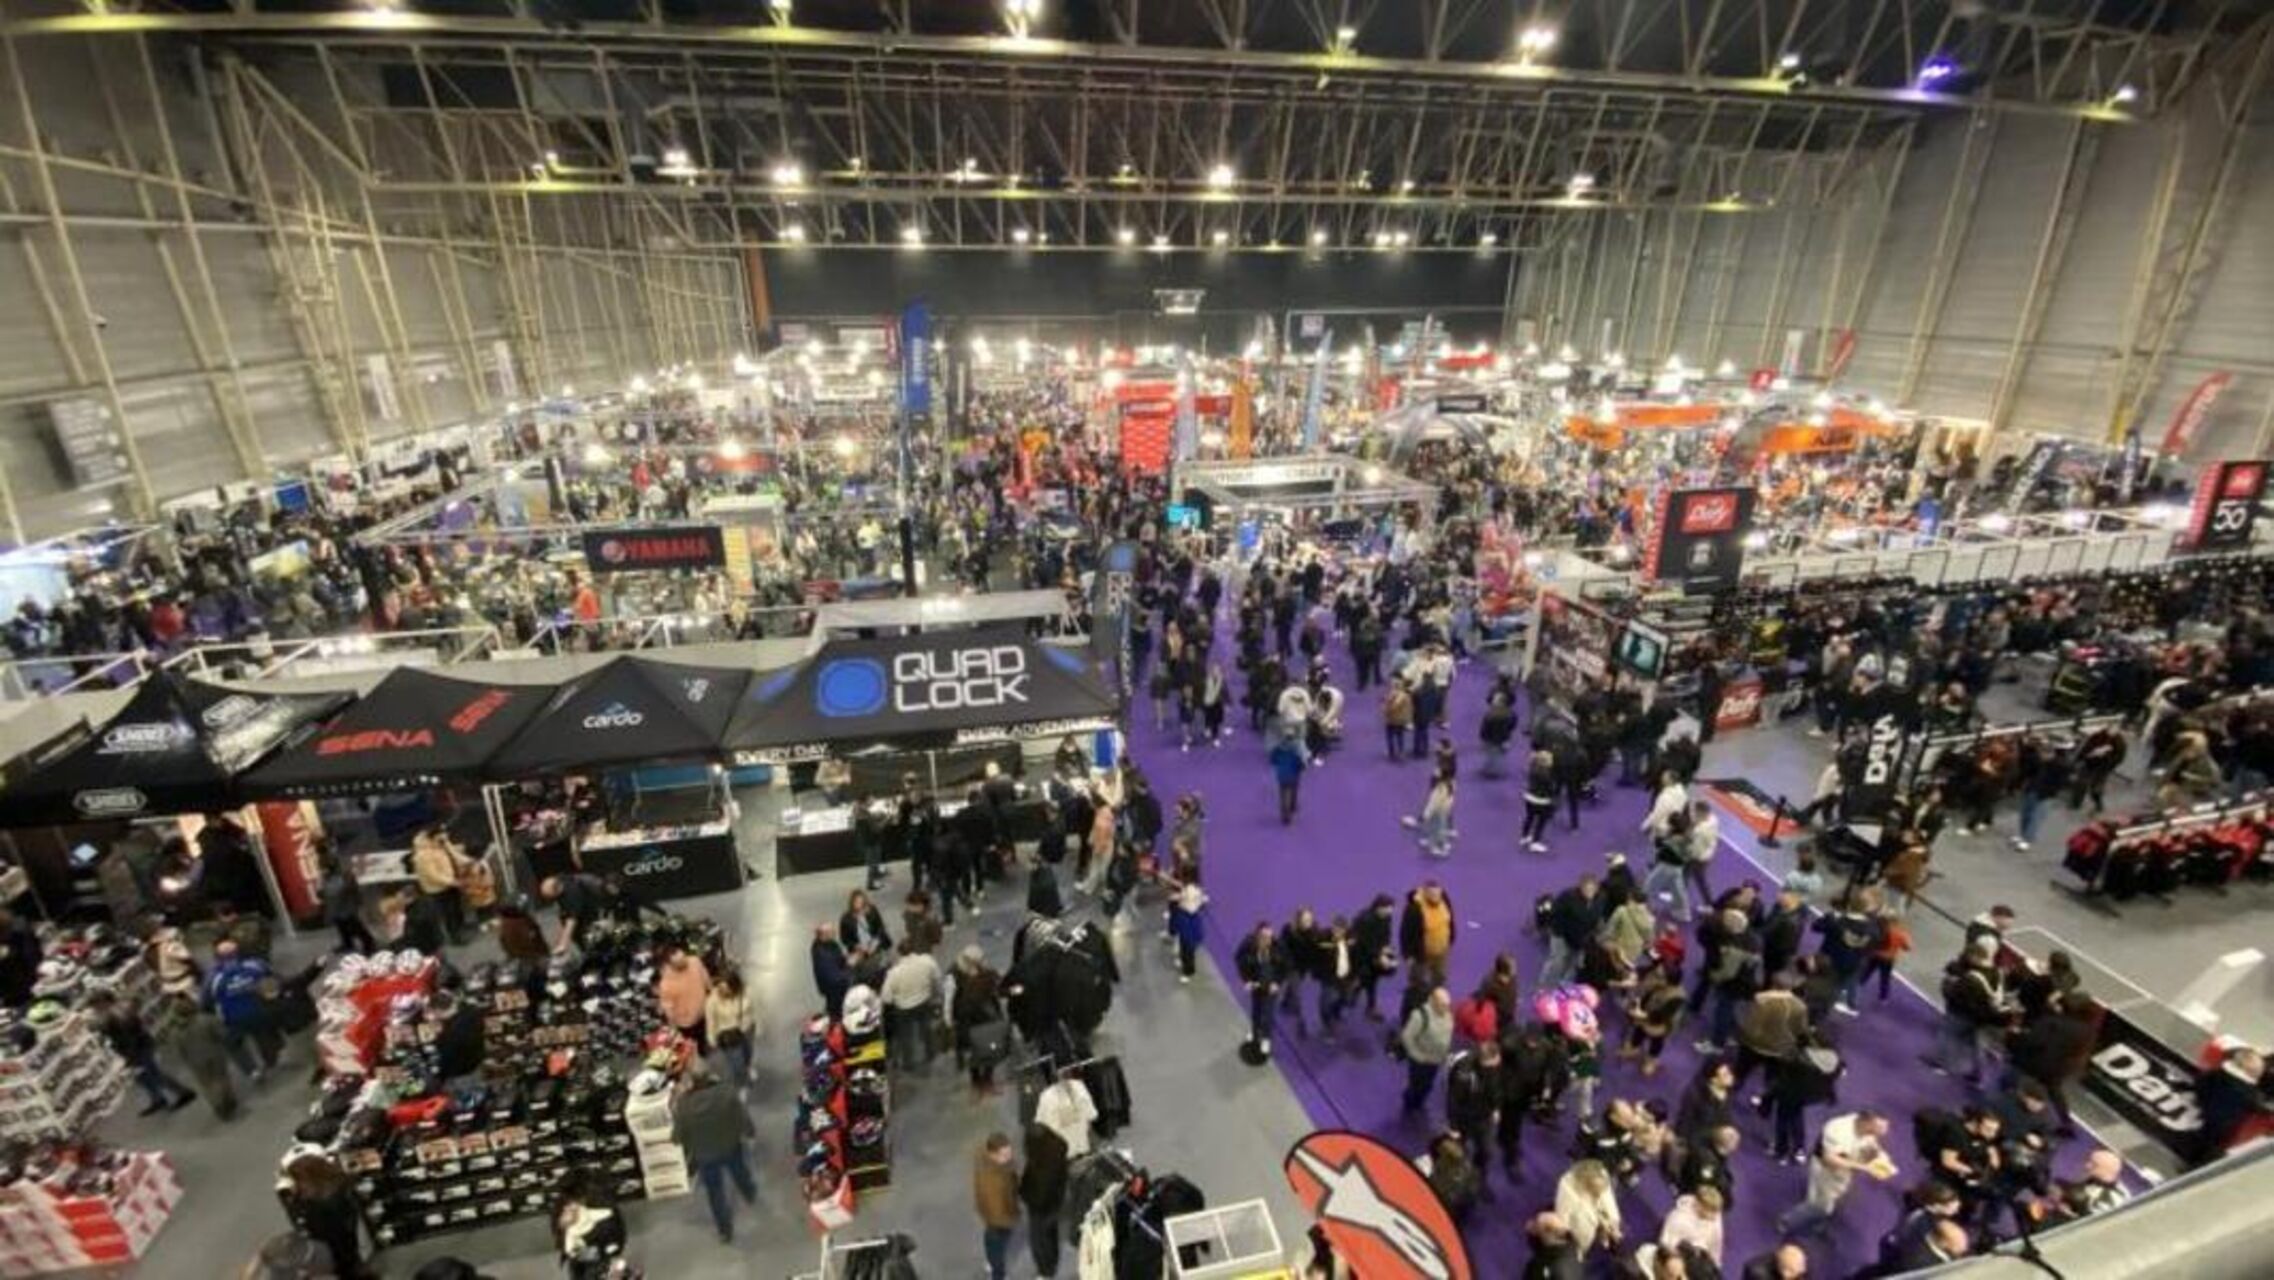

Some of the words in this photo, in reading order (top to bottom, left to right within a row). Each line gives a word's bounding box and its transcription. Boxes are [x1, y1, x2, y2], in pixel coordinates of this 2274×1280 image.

[2213, 500, 2248, 531] 50
[626, 535, 712, 560] YAMAHA
[894, 645, 1025, 682] QUAD
[894, 673, 1029, 712] LOCK
[583, 712, 643, 729] cardo
[318, 728, 434, 756] SENA
[793, 742, 829, 760] DAY
[623, 855, 684, 876] cardo
